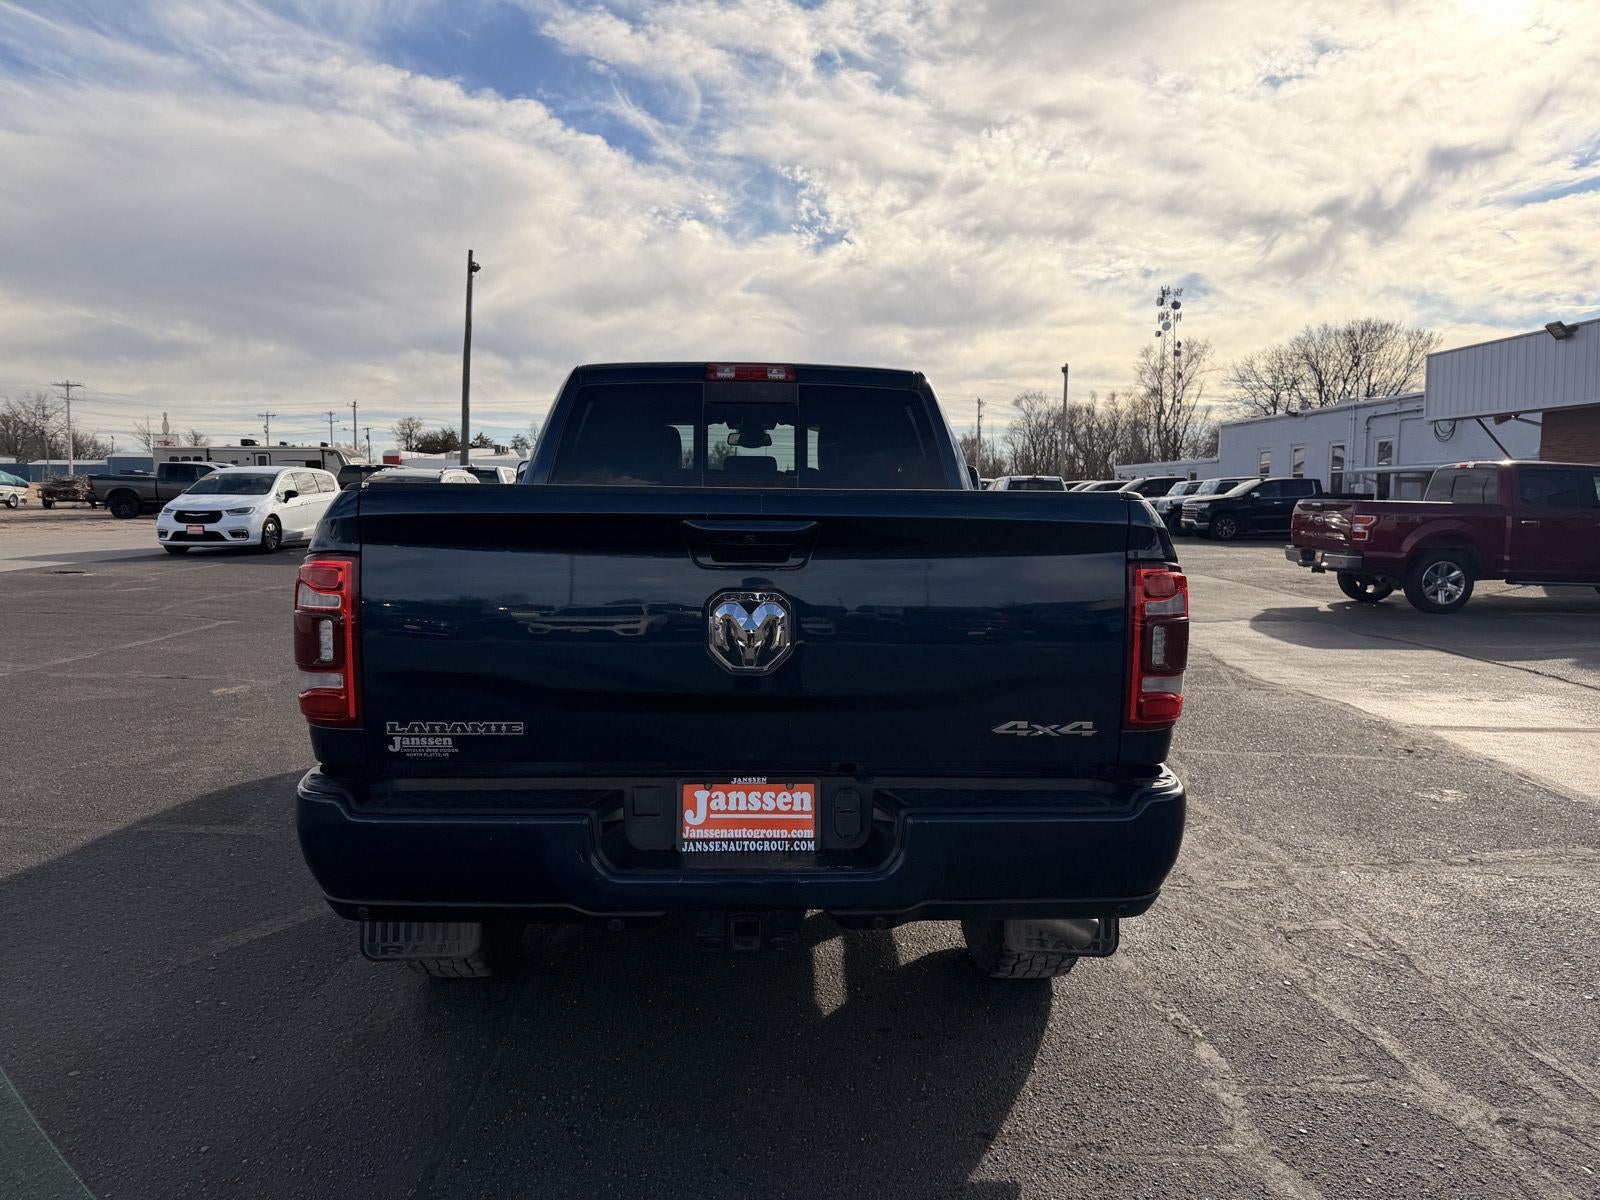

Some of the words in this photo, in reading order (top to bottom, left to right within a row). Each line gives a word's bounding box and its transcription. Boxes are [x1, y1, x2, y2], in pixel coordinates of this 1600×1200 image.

[386, 721, 524, 735] LARAMIE
[991, 720, 1099, 737] 4x4
[387, 736, 453, 752] Janssen
[684, 790, 813, 825] Janssen
[682, 826, 814, 839] Janssenautogroup.com
[682, 840, 815, 852] JANSSENAUTOGROUP.COM
